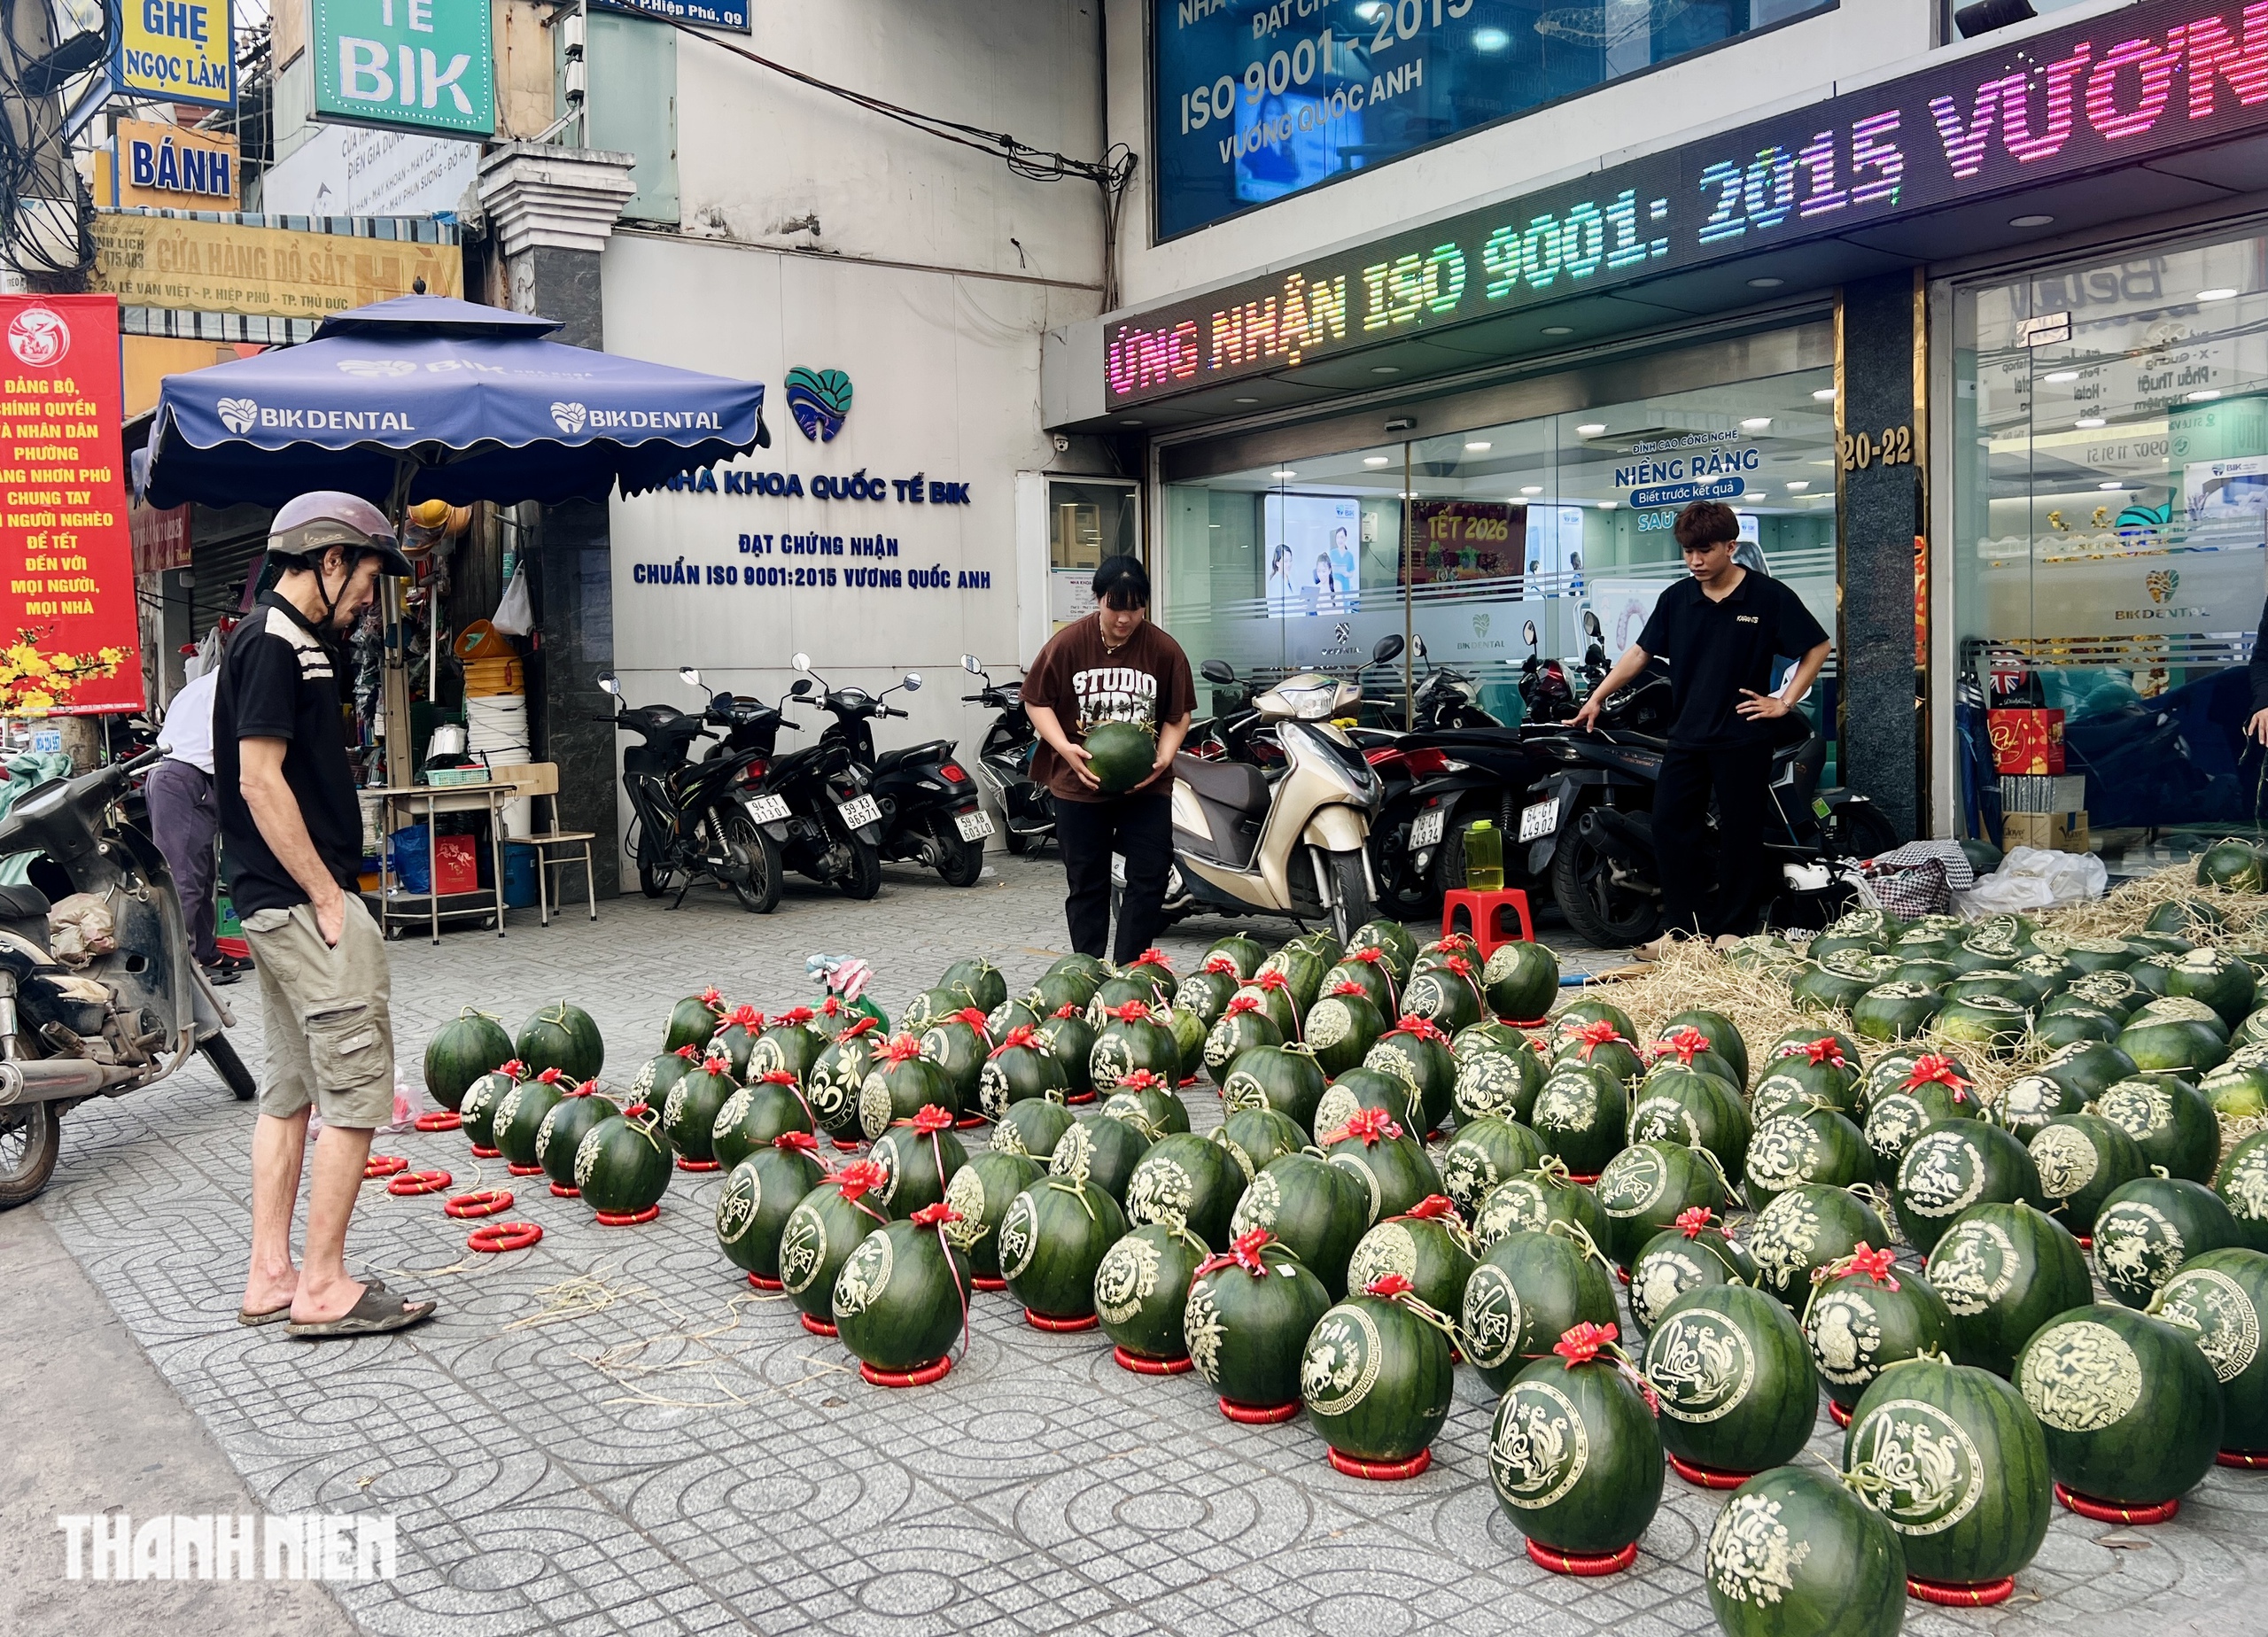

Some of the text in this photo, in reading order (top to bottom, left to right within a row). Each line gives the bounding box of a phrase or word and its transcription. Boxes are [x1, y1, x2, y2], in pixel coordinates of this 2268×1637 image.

[144, 0, 207, 50] GHẸ
[688, 6, 720, 22] Phú,
[724, 12, 742, 25] Q9
[1253, 3, 1291, 39] ĐẠT
[126, 49, 227, 89] NGỌC LÂM
[338, 35, 473, 115] BIK
[1182, 75, 1236, 135] ISO
[1245, 28, 1332, 105] 9001
[1370, 0, 1474, 54] 2015
[1219, 114, 1293, 164] VƯƠNG
[1298, 81, 1363, 132] QUỐC
[1369, 58, 1423, 105] ANH
[368, 142, 381, 165] GIA
[129, 136, 232, 198] BÁNH
[385, 167, 406, 192] KHOAN
[1208, 272, 1347, 369] NHẬN
[1363, 242, 1467, 332] ISO
[1699, 109, 1905, 245] 2015
[157, 228, 201, 275] CỬA
[208, 237, 267, 281] HÀNG
[274, 238, 303, 284] ĐỒ
[309, 241, 347, 286] SẮT
[101, 277, 348, 311] 24 LÊ VĂN VIỆT P. HIỆP PHÚ TP. THỦ ĐỨC
[425, 359, 509, 376] BIK
[4, 376, 80, 397] ĐẢNG BỘ,
[0, 399, 97, 417] HÍNH QUYỀN
[0, 422, 98, 438] À NHÂN DÂN
[1658, 438, 1678, 451] CAO
[1680, 433, 1709, 446] CÔNG
[1711, 428, 1738, 442] NGHỆ
[14, 444, 79, 461] PHƯỜNG
[1842, 426, 1911, 471] 20-22
[31, 468, 75, 483] NHƠN
[79, 466, 112, 483] PHÚ
[1615, 448, 1759, 488] NIỀNG RĂNG
[7, 492, 91, 506] CHUNG TAY
[724, 470, 804, 498] KHOA
[811, 469, 887, 503] QUỐC
[891, 472, 925, 503] TẾ
[929, 481, 971, 506] BIK
[1639, 480, 1734, 503] Biết trước kết quả
[7, 510, 57, 527] NGƯỜI
[60, 510, 113, 527] NGHÈO
[1427, 504, 1508, 541] TẾT 2026
[27, 530, 78, 549] ĐỂ TẾT
[738, 531, 899, 560] ĐẠT CHỨNG NHẬN
[26, 554, 87, 571] ĐẾN VỚI
[633, 555, 990, 589] CHUẨN ISO 9001:2015 VƯƠNG QUỐC ANH
[11, 576, 100, 596] MỌI NGƯỜI,
[26, 598, 94, 617] MỌI NHÀ
[1072, 667, 1157, 699] STUDIO
[752, 797, 779, 811] 94-E1
[844, 797, 871, 815] 59-X3
[1526, 802, 1552, 823] 64-G1
[1452, 1152, 1480, 1171] 2026
[1496, 1189, 1527, 1206] 2026
[2108, 1217, 2149, 1235] 2026
[1716, 1576, 1747, 1602] 2026
